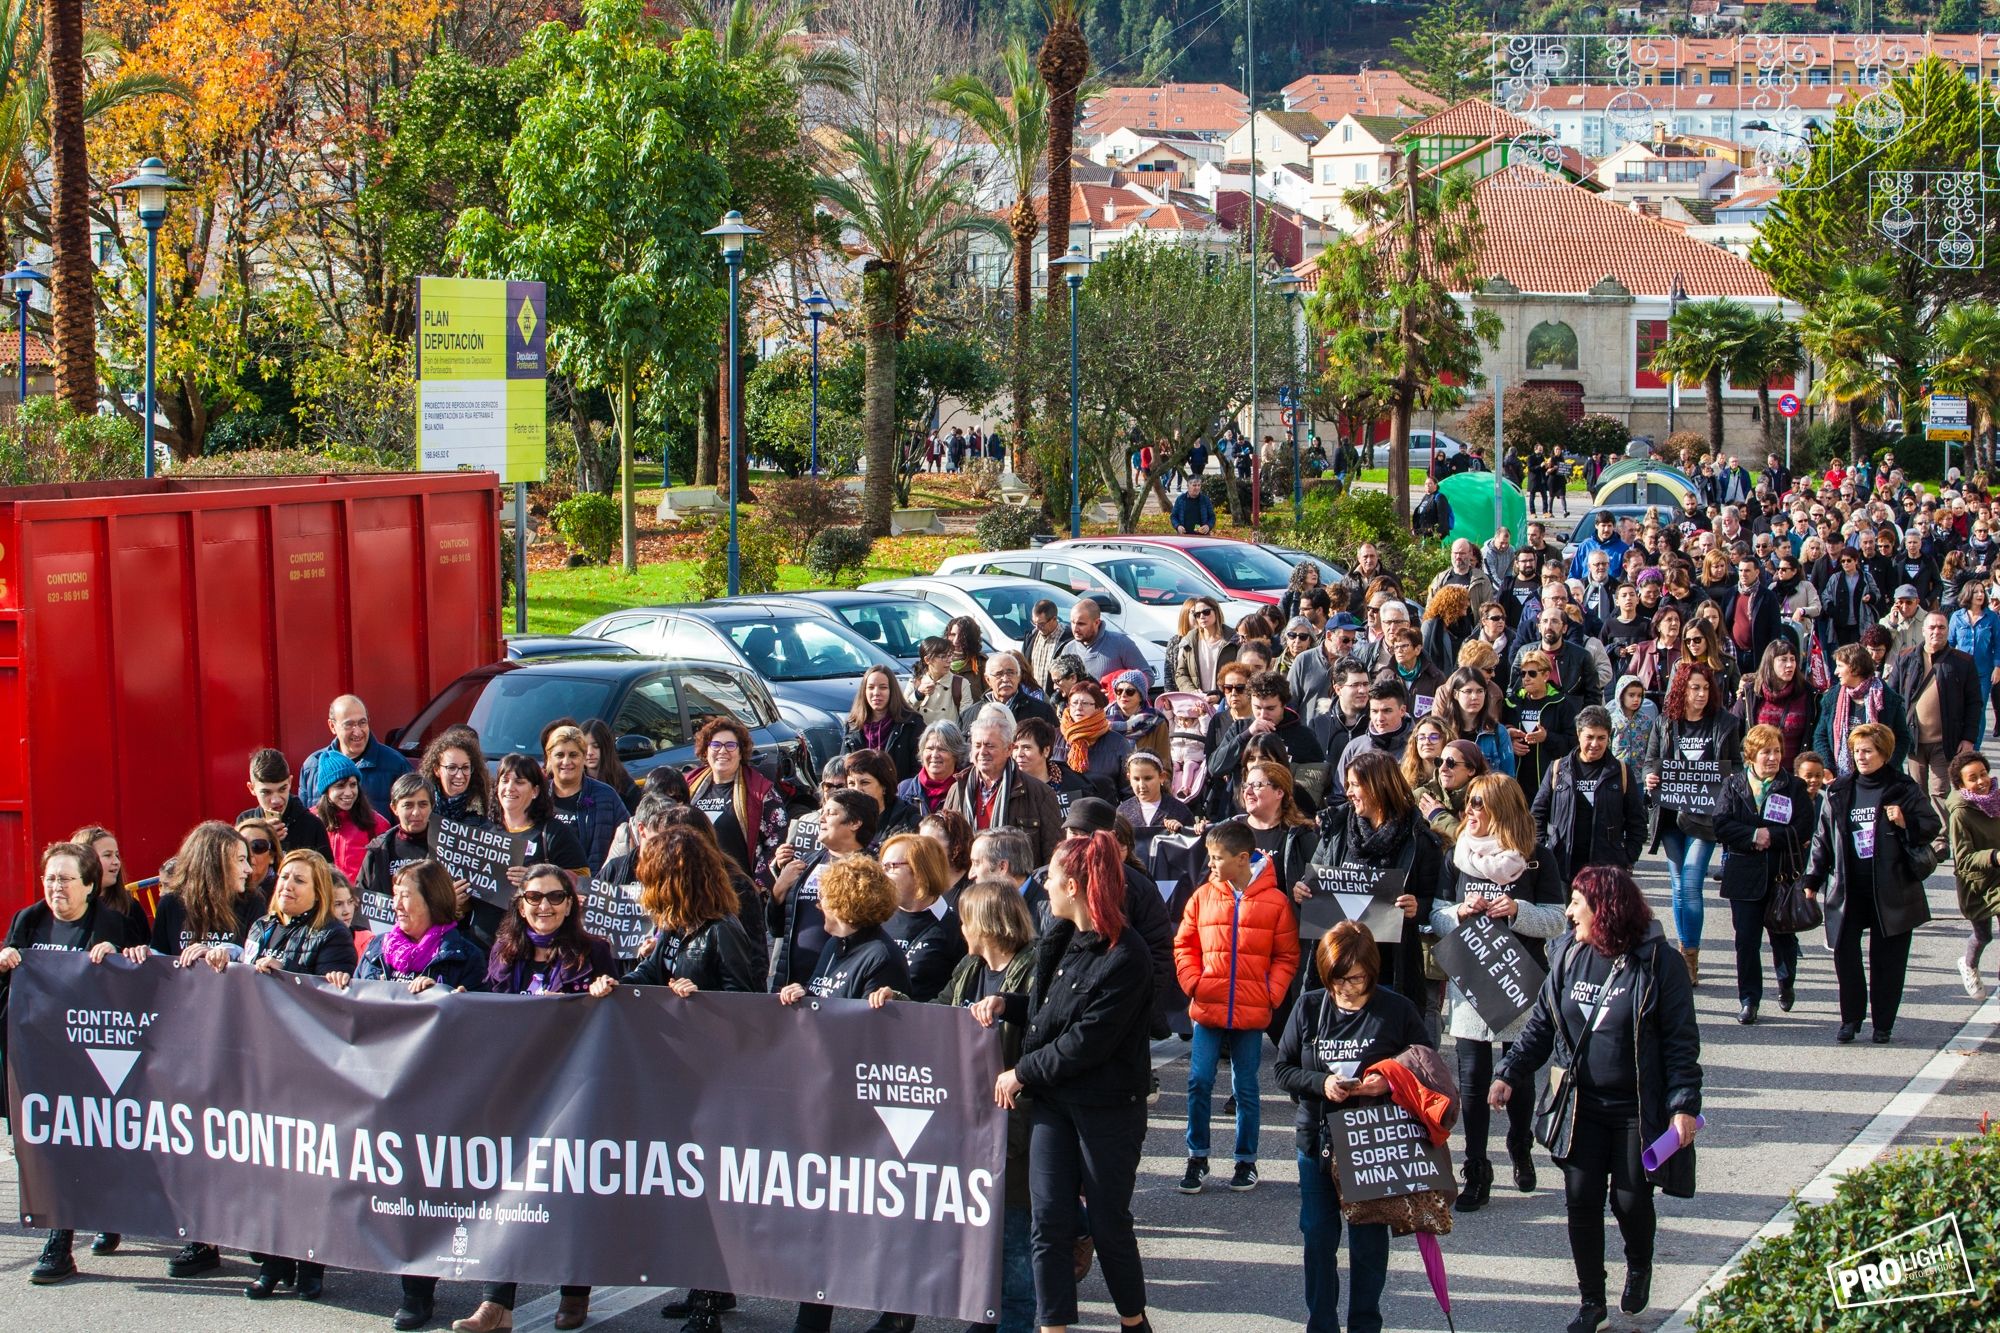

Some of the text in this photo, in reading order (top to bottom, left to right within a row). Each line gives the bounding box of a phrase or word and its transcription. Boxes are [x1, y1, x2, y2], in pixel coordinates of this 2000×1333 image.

[424, 310, 448, 326] PLAN
[424, 329, 484, 350] DEPUTACIÓN
[516, 351, 538, 360] Deputación
[516, 360, 538, 370] Pontevedra
[440, 538, 468, 549] CONTUCHO
[290, 552, 324, 564] CONTUCHO
[47, 572, 88, 585] CONTUCHO
[1662, 760, 1719, 771] SON LIBRE
[1662, 771, 1721, 782] DE DECIDIR
[1661, 782, 1708, 793] SOBRE A
[1660, 793, 1715, 806] MIÑA VIDA
[1851, 807, 1876, 815] CONTR
[440, 818, 512, 850] SON LIBRE
[795, 836, 810, 849] DE
[438, 832, 511, 866] DE DECIDIR
[436, 846, 492, 874] SOBRE A
[469, 871, 497, 892] VIDA
[1318, 868, 1367, 882] CONTRA
[590, 879, 618, 898] SON
[1465, 883, 1501, 891] CONTRA
[362, 892, 395, 909] CONTR
[588, 894, 605, 910] DE
[584, 911, 641, 932] SOBRE A
[620, 935, 646, 947] VIDA
[1475, 915, 1494, 939] SI,
[1492, 935, 1508, 950] É
[1460, 927, 1528, 1008] NON, É NON
[67, 1009, 135, 1027] CONTRA
[856, 1063, 932, 1084] CANGAS
[856, 1083, 881, 1101] EN
[1344, 1108, 1379, 1127] SON
[1348, 1130, 1370, 1147] DE
[21, 1093, 992, 1227] CANGAS CONTRA AS VIOLENCIAS MACHISTAS
[1351, 1142, 1425, 1166] SOBRE A
[1355, 1161, 1439, 1185] MIÑA VIDA
[371, 1196, 549, 1224] Consello Municipal de Igualdade
[437, 1255, 456, 1263] Concello
